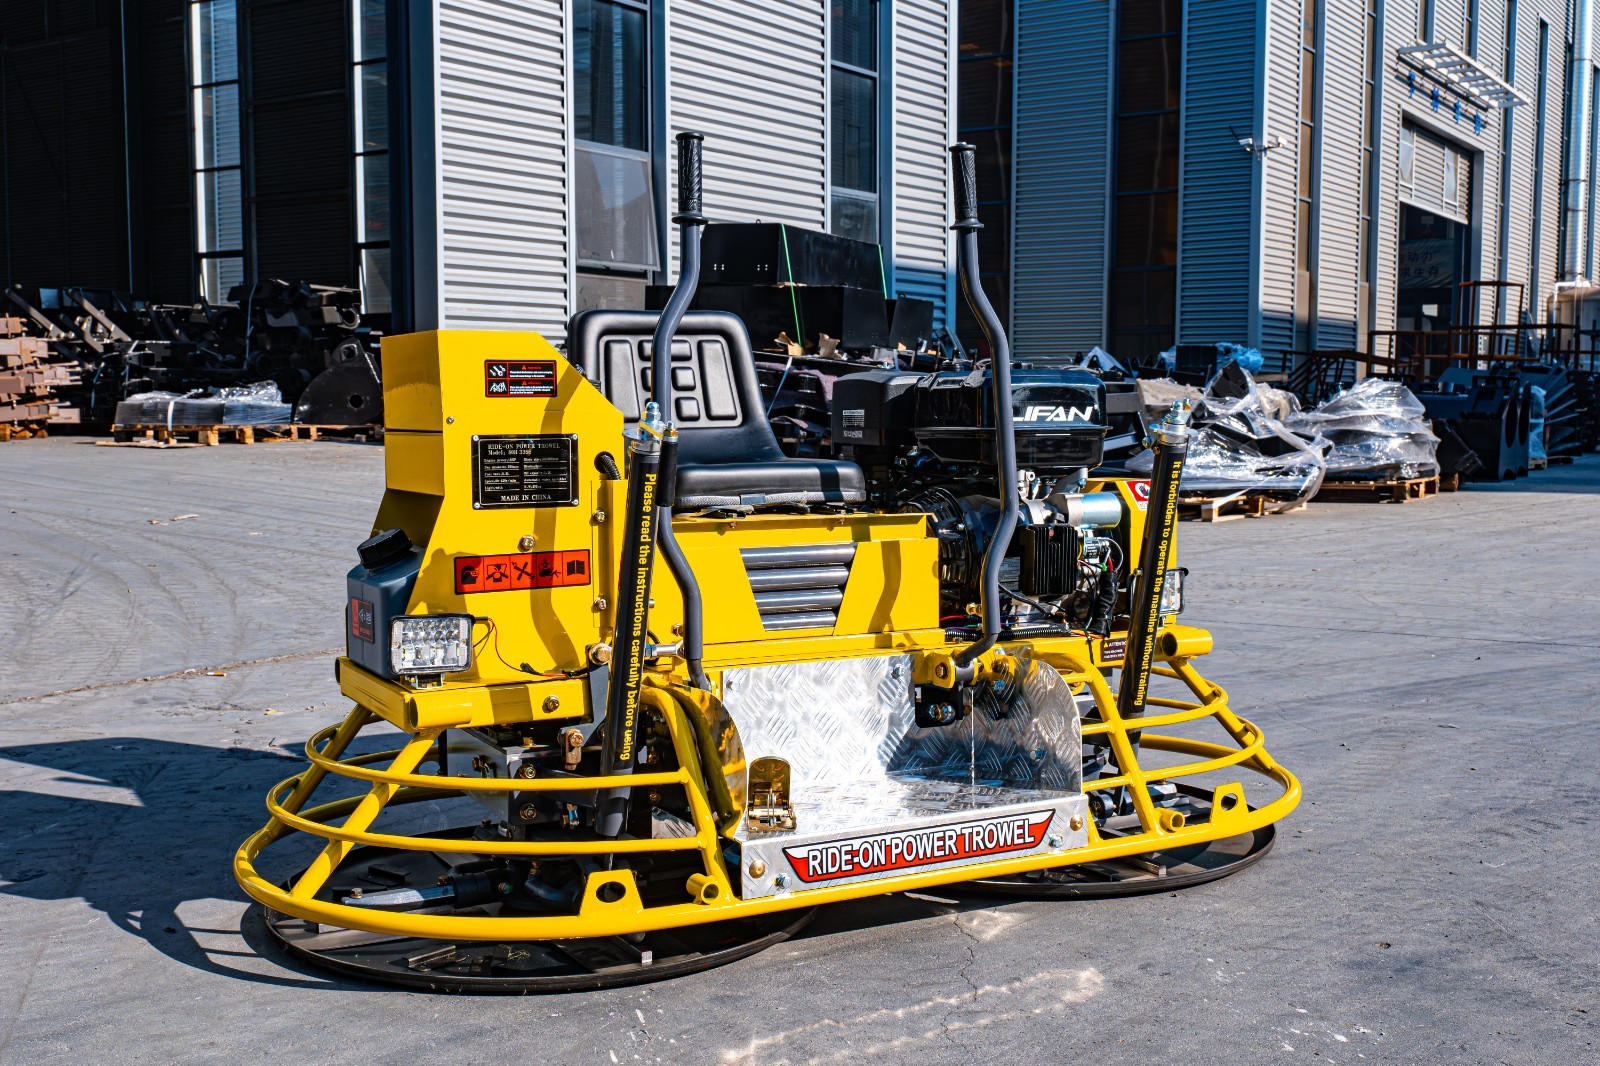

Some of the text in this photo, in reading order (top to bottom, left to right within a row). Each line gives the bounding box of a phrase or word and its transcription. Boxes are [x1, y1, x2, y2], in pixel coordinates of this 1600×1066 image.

[1171, 470, 1181, 479] is
[1165, 481, 1179, 526] forbidden
[1162, 527, 1173, 538] to
[1157, 540, 1171, 576] operate
[1153, 577, 1164, 593] the
[620, 473, 657, 761] Please read the instructions carefully before using
[1147, 594, 1160, 633] machine
[1141, 635, 1154, 671] without
[1134, 671, 1149, 706] training
[807, 818, 1036, 877] RIDE-ON POWER TROWEL
